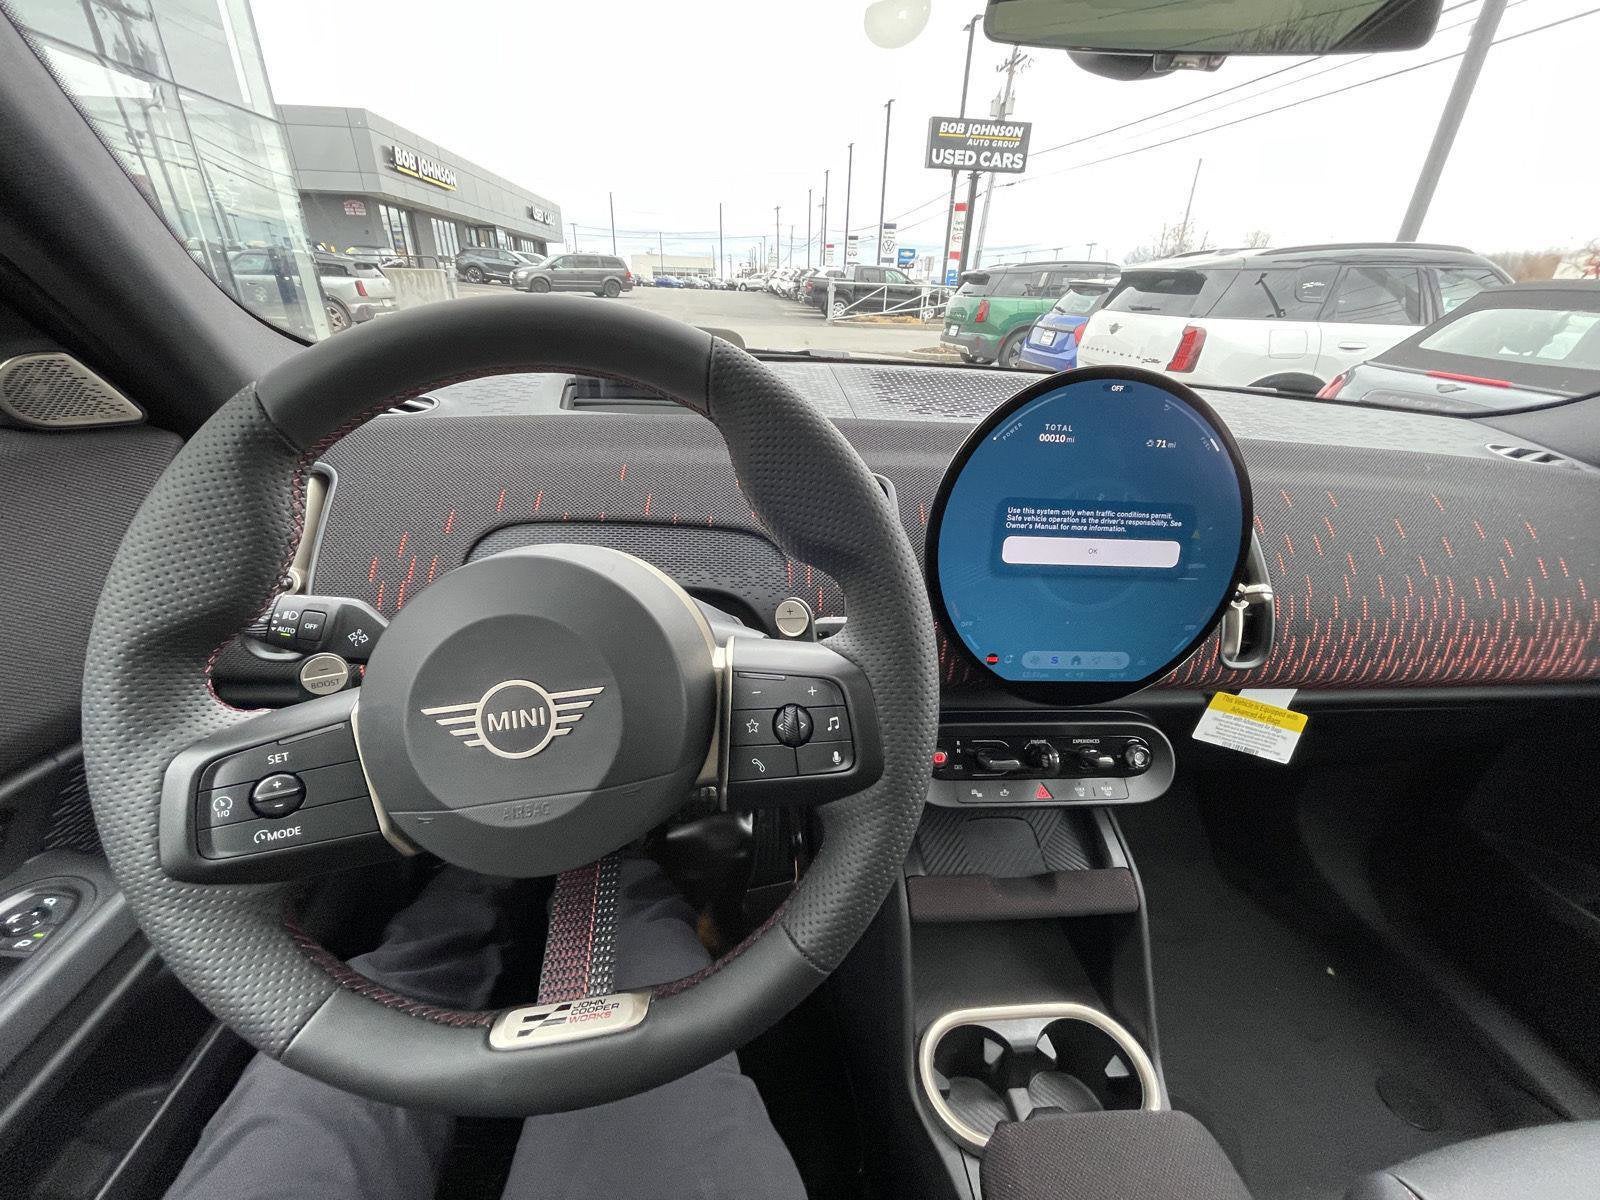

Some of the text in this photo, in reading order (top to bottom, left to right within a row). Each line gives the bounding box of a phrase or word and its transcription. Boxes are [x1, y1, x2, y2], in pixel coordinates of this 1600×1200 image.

[939, 121, 1025, 138] BOB JOHNSON
[966, 138, 1020, 149] AUTO GROUP
[931, 148, 1024, 169] USED CARS
[394, 145, 457, 187] BOB JOHNSON
[1111, 384, 1125, 392] OFF
[1002, 422, 1023, 441] POWER
[1045, 423, 1073, 432] TOTAL
[1039, 433, 1066, 443] 00010
[1156, 439, 1177, 449] 71 mi
[1007, 506, 1173, 520] Use this system only when traffic conditions permit.
[1005, 521, 1033, 529] Owner's
[1034, 522, 1059, 530] Manual
[1060, 523, 1070, 531] for
[1088, 524, 1126, 532] information.
[1023, 514, 1047, 522] vehicle
[1048, 516, 1080, 525] operation
[1081, 516, 1087, 524] is
[1100, 517, 1124, 525] driver's
[1125, 518, 1169, 528] responsibility.
[1087, 547, 1098, 555] OK
[276, 626, 296, 635] AUTO
[304, 622, 318, 630] OFF
[356, 628, 362, 636] R
[310, 678, 340, 690] BOOST
[487, 706, 546, 732] MINI
[267, 752, 290, 765] SET
[267, 826, 302, 841] MODE
[570, 1002, 620, 1016] COOPER
[573, 998, 606, 1009] JOHN
[568, 1010, 612, 1023] WORKS
